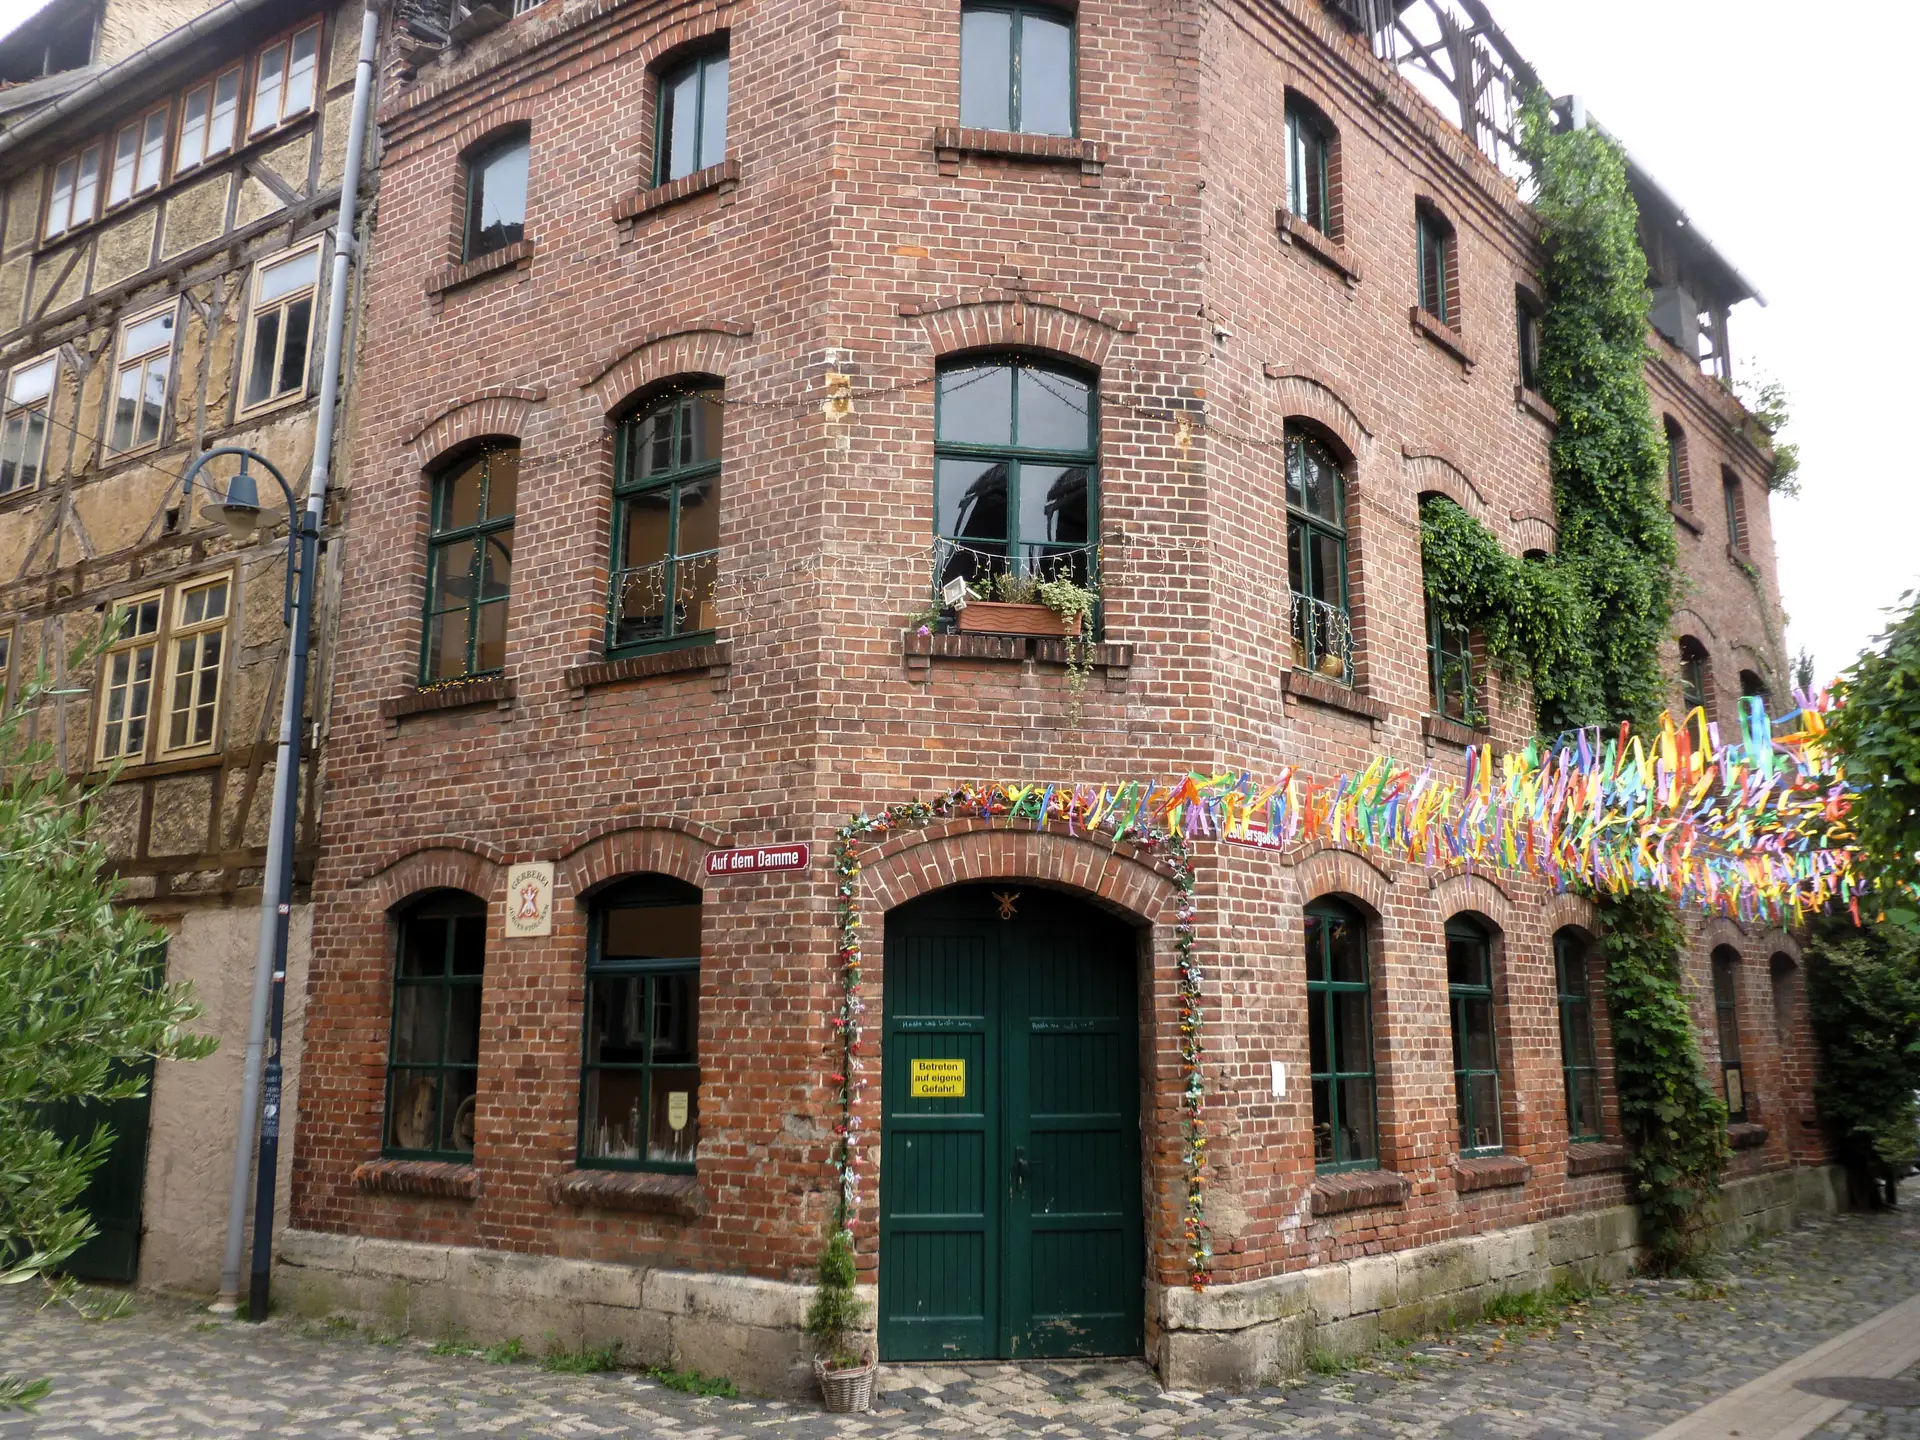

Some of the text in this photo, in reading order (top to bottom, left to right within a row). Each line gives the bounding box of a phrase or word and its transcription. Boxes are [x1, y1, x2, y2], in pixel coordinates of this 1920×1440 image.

[710, 850, 799, 871] Auf dem Damme
[511, 870, 550, 891] GERBEREI
[919, 1062, 958, 1071] Betreten
[914, 1073, 962, 1083] auf eigene
[921, 1084, 955, 1093] Gefahr!
